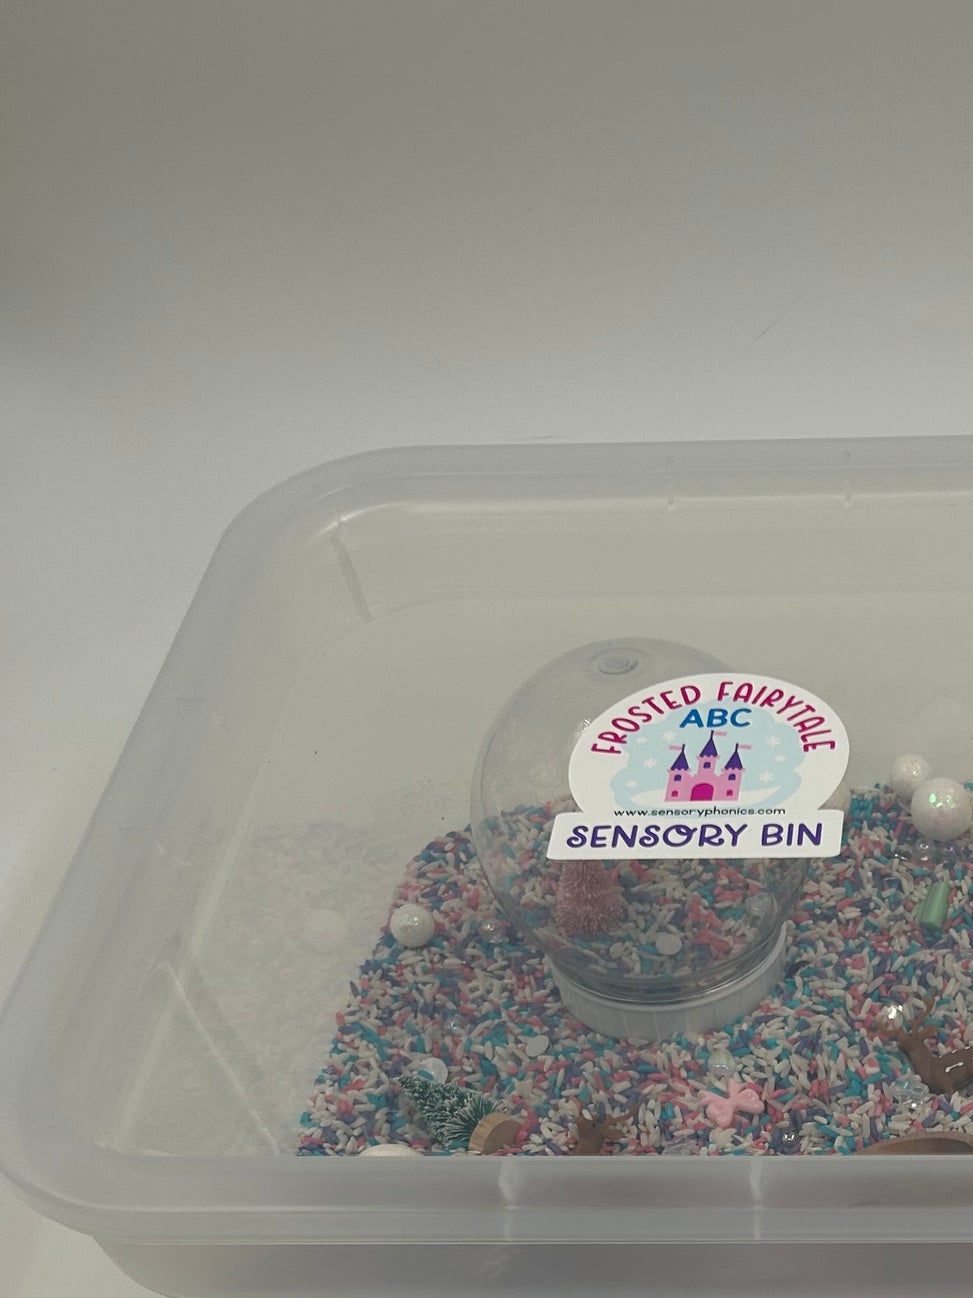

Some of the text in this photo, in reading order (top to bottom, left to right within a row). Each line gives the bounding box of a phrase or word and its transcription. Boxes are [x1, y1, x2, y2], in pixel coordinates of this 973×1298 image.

[591, 681, 836, 755] FROSTED FAIRYTALE
[679, 708, 752, 729] ABC
[613, 805, 786, 818] www.sensoryphonics.com
[566, 823, 823, 849] SENSORY BIN
